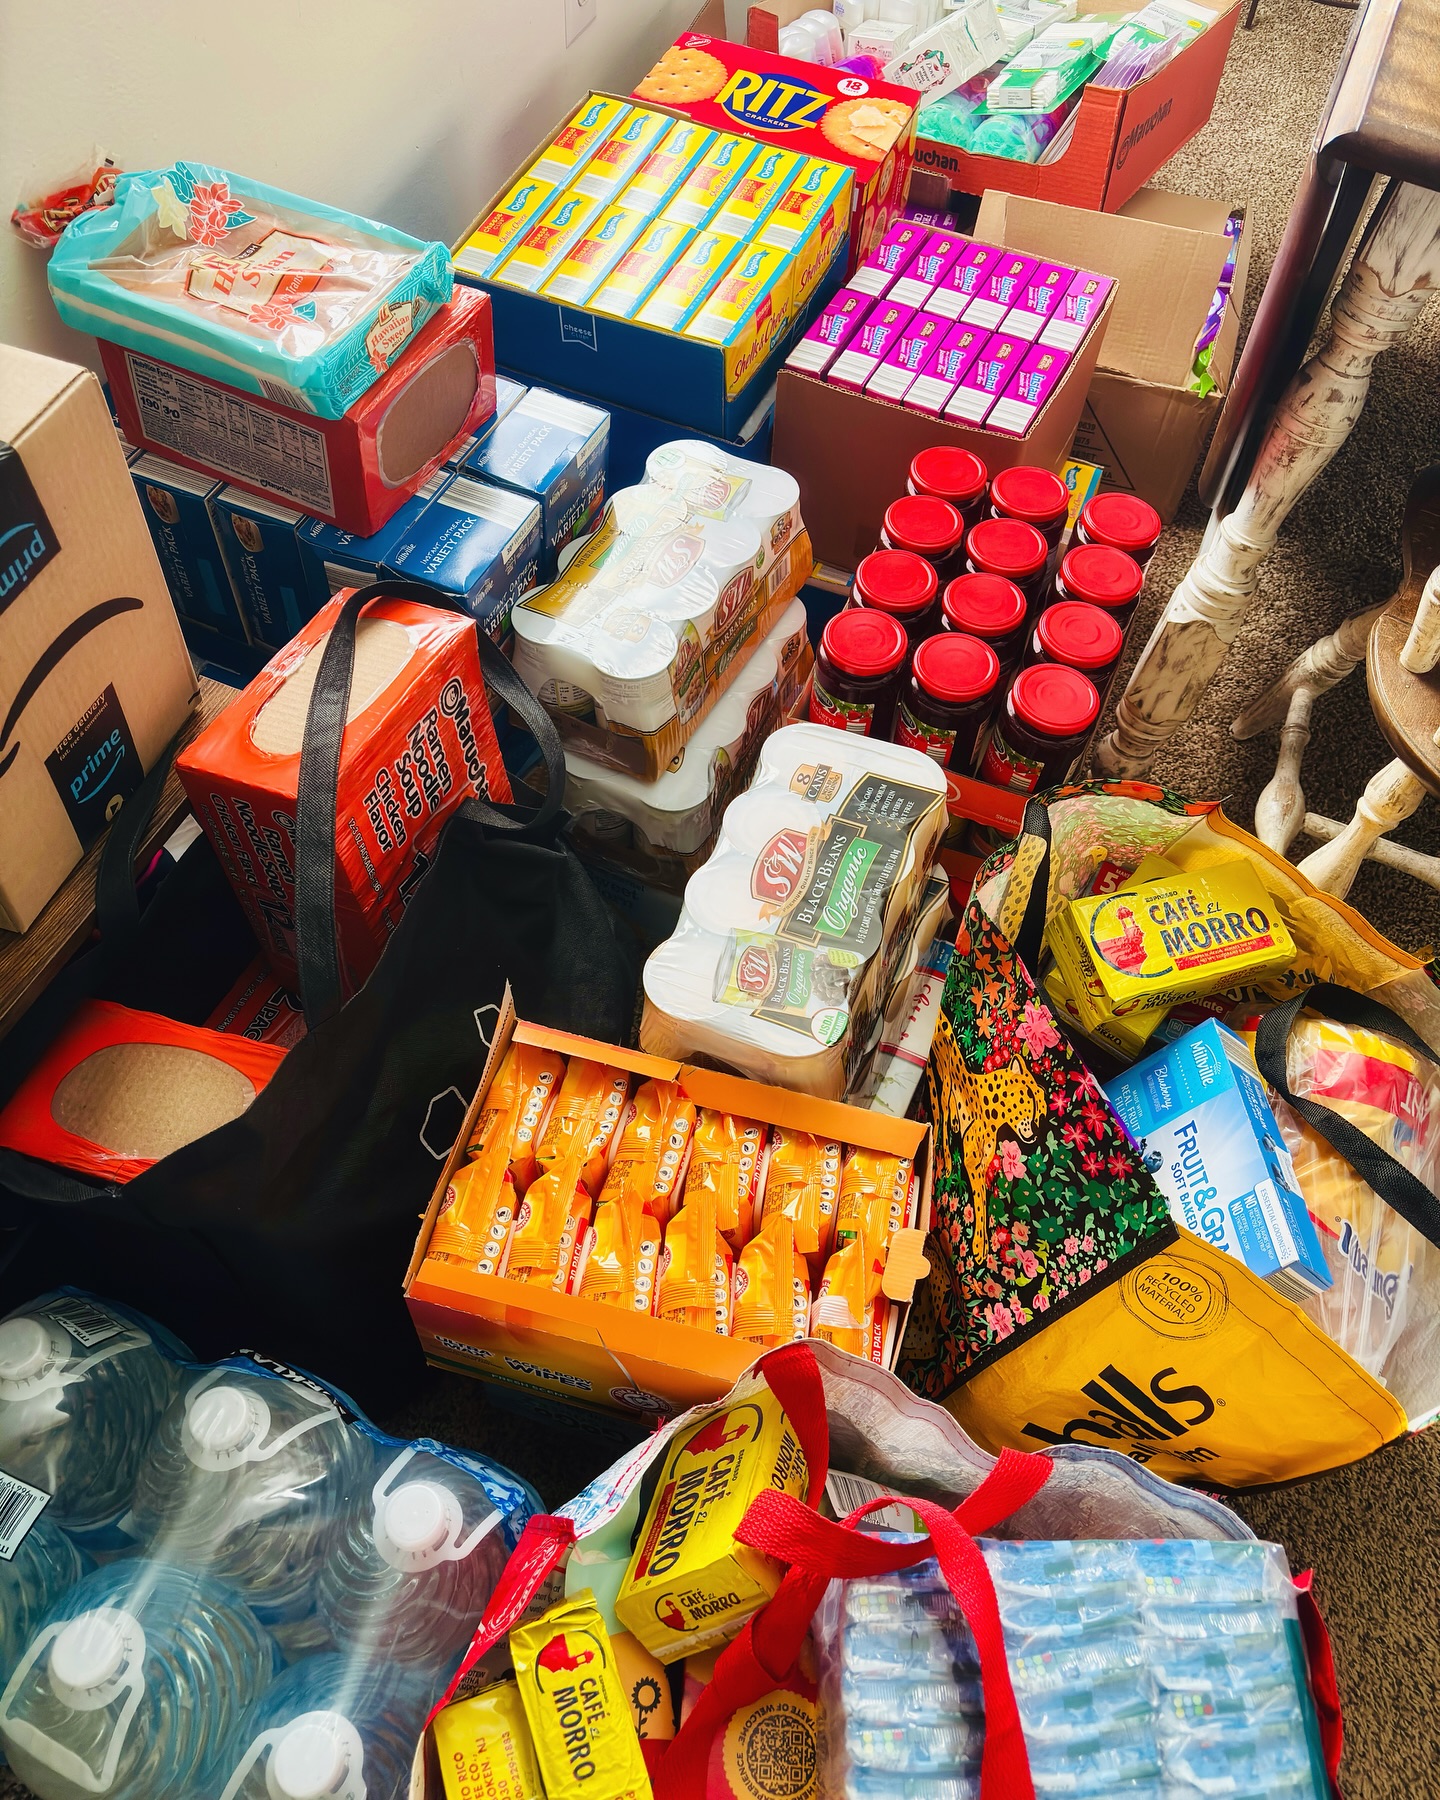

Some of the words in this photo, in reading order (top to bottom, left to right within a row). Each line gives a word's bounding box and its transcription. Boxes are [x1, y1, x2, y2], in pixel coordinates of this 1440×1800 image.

[713, 69, 835, 129] RITZ
[845, 80, 862, 90] 18
[585, 104, 602, 126] Original
[629, 117, 645, 140] Original
[745, 112, 790, 129] CRACKERS
[719, 143, 737, 166] Original
[763, 156, 780, 178] Original
[808, 169, 825, 190] Original
[512, 188, 530, 211] Original
[557, 202, 575, 224] Original
[602, 215, 620, 238] Original
[745, 254, 763, 277] Original
[885, 245, 903, 270] Instant
[925, 256, 942, 281] Instant
[285, 275, 303, 295] Trans
[961, 267, 978, 291] Instant
[999, 277, 1015, 302] Instant
[1036, 287, 1053, 312] Instant
[1076, 297, 1092, 322] Instant
[371, 315, 410, 348] Hawaiian
[381, 327, 407, 349] Sweet
[564, 324, 592, 337] cheese
[828, 315, 848, 342] Instant
[870, 327, 889, 354] Instant
[734, 338, 759, 384] Shells
[907, 340, 927, 368] Instant
[945, 351, 964, 378] Instant
[140, 396, 160, 411] 190
[505, 446, 536, 479] VARIETY
[532, 425, 553, 451] PACK
[551, 503, 587, 546] VARIETY
[587, 475, 606, 504] PACK
[777, 518, 785, 531] 8
[161, 526, 179, 559] PACK
[420, 542, 441, 565] INSTANT
[439, 518, 462, 542] OATMEAL
[424, 539, 456, 575] VARIETY
[452, 516, 477, 544] PACK
[772, 523, 791, 546] CANS
[0, 529, 46, 597] prim
[395, 542, 417, 565] Millville
[656, 538, 691, 580] S&W
[172, 557, 193, 598] VARIETY
[517, 560, 538, 595] PACK
[253, 584, 273, 624] VARIETY
[719, 570, 750, 626] S&W
[631, 624, 645, 635] 8
[714, 596, 758, 655] GARBANZOS
[74, 692, 105, 733] delivery
[422, 707, 453, 796] Ramen
[452, 695, 492, 801] Marucha
[70, 729, 121, 800] prime
[407, 723, 441, 814] Noodle
[797, 772, 811, 785] 8
[395, 751, 423, 819] Soup
[807, 768, 827, 798] CANS
[375, 768, 408, 848] Chicken
[857, 786, 874, 812] NON-GMO
[881, 789, 896, 811] PROTEIN
[893, 797, 904, 812] FIBER
[904, 801, 915, 815] FREE
[209, 792, 239, 850] Chicken
[362, 790, 393, 853] Flavor
[231, 796, 270, 859] Noodle
[263, 855, 288, 900] Soup
[261, 826, 296, 885] Ramen
[763, 834, 806, 898] S&W
[797, 878, 828, 925] BLACK
[817, 834, 847, 878] BEANS
[822, 847, 868, 930] Organic
[1145, 890, 1179, 903] ESPRESSO
[1148, 890, 1204, 928] CAFÉ
[1207, 900, 1222, 915] EL
[1160, 907, 1271, 959] MORRO
[741, 950, 770, 991] S&W
[770, 976, 785, 1004] BLACK
[778, 948, 791, 974] BEANS
[785, 953, 807, 1006] Organic
[1140, 990, 1197, 1011] MORRO
[243, 1006, 280, 1042] PAC
[818, 1013, 835, 1036] USDA
[830, 1012, 849, 1043] ORGANIC
[1189, 1039, 1215, 1089] Millville
[1155, 1064, 1173, 1111] Blueberry
[1121, 1084, 1132, 1106] REAL
[1127, 1106, 1140, 1131] FRUIT
[1173, 1119, 1209, 1186] FRUIT
[1194, 1186, 1218, 1212] &
[1170, 1161, 1187, 1191] SOFT
[1179, 1192, 1199, 1231] BAKED
[1231, 1201, 1244, 1216] NO
[1244, 1194, 1257, 1209] NO
[1261, 1188, 1276, 1222] ESSENTIAL
[1273, 1222, 1288, 1257] GOODNESS
[571, 1242, 582, 1269] PACK
[1144, 1275, 1196, 1314] RECYCLED
[1162, 1271, 1203, 1302] 100%
[1137, 1284, 1188, 1321] MATERIAL
[873, 1322, 882, 1349] PACK
[505, 1361, 593, 1392] WIPES
[772, 1433, 794, 1490] MORRO
[700, 1454, 735, 1509] CAFÉ
[648, 1465, 709, 1576] MORRO
[694, 1511, 708, 1526] EL
[680, 1588, 707, 1608] CAFÉ
[689, 1591, 741, 1621] MORRO
[578, 1676, 611, 1726] CAFÉ
[777, 1703, 789, 1711] OF
[553, 1685, 596, 1782] MORRO
[738, 1704, 775, 1742] WELCOME
[791, 1705, 817, 1731] TASTE
[476, 1737, 487, 1754] NJ
[453, 1751, 468, 1782] RICO
